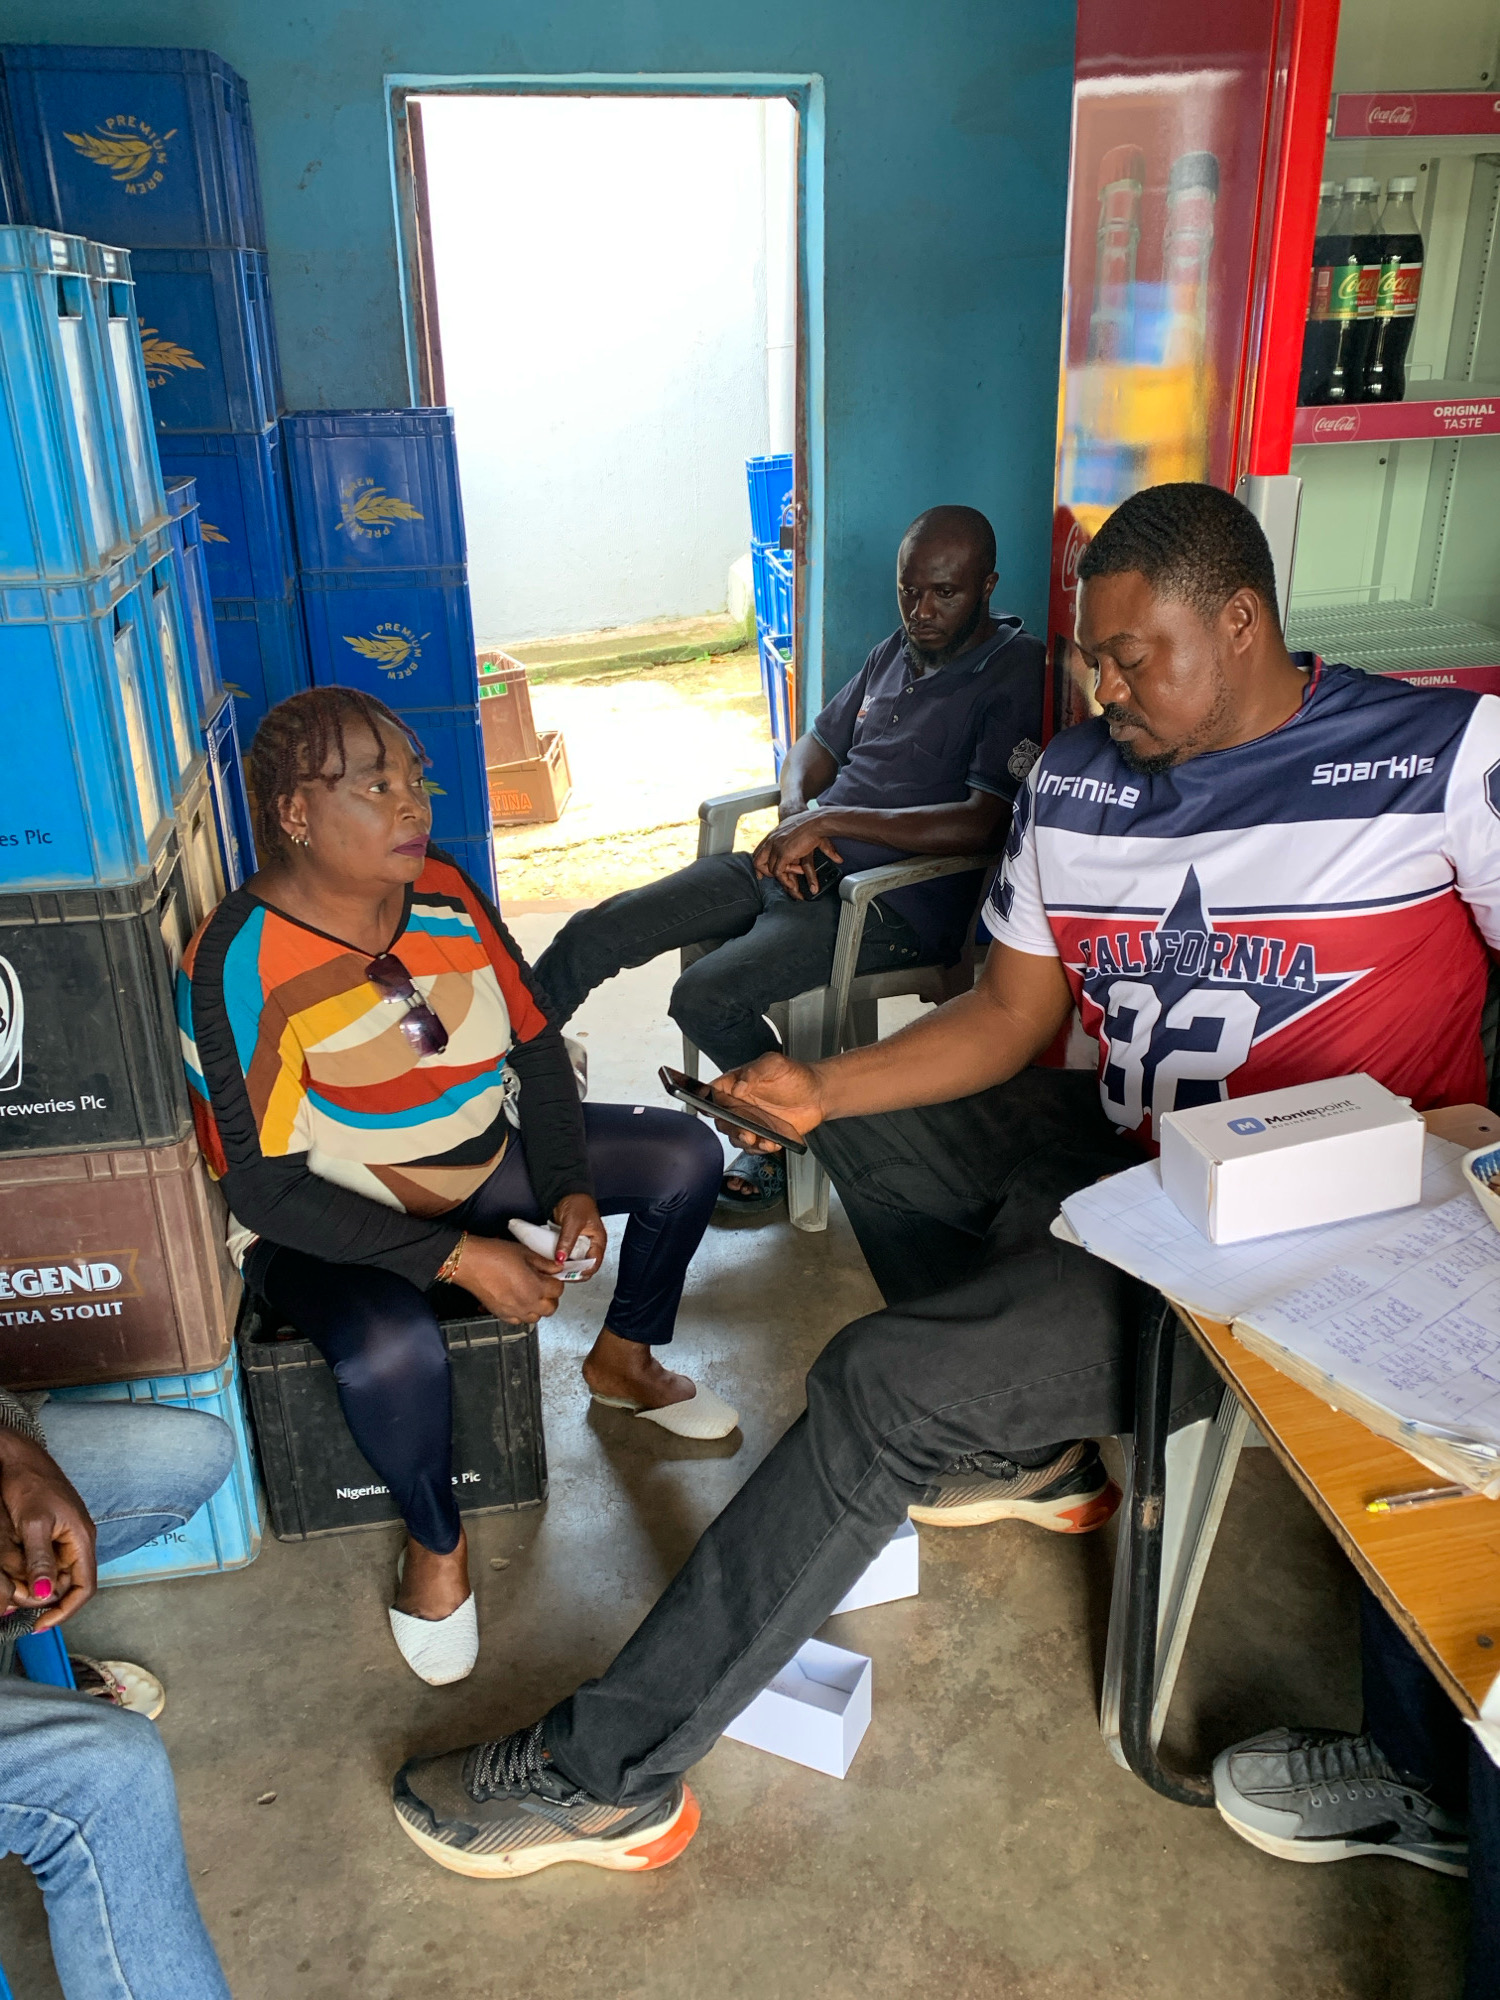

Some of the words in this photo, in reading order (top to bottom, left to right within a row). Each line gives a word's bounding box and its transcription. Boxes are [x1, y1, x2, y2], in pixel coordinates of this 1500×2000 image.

[105, 114, 167, 164] PREMIUM
[125, 170, 164, 195] BREW
[1433, 404, 1496, 418] ORIGINAL
[1443, 417, 1484, 430] TASTE
[343, 477, 375, 498] BREW
[375, 622, 422, 658] PREMIUM
[386, 661, 419, 680] BREW
[490, 792, 533, 812] TINA
[24, 829, 53, 845] Plc
[1078, 929, 1319, 994] CALIFORNIA
[1100, 980, 1262, 1143] 32
[0, 1098, 76, 1117] reweries
[80, 1094, 107, 1110] Plc
[1264, 1100, 1355, 1125] Moniepoint
[1271, 1115, 1317, 1129] BUSINESS
[1322, 1105, 1362, 1118] BANKING
[0, 1262, 123, 1299] EGEND
[0, 1310, 46, 1327] TRA
[50, 1301, 123, 1322] STOUT
[163, 1532, 187, 1545] Plc
